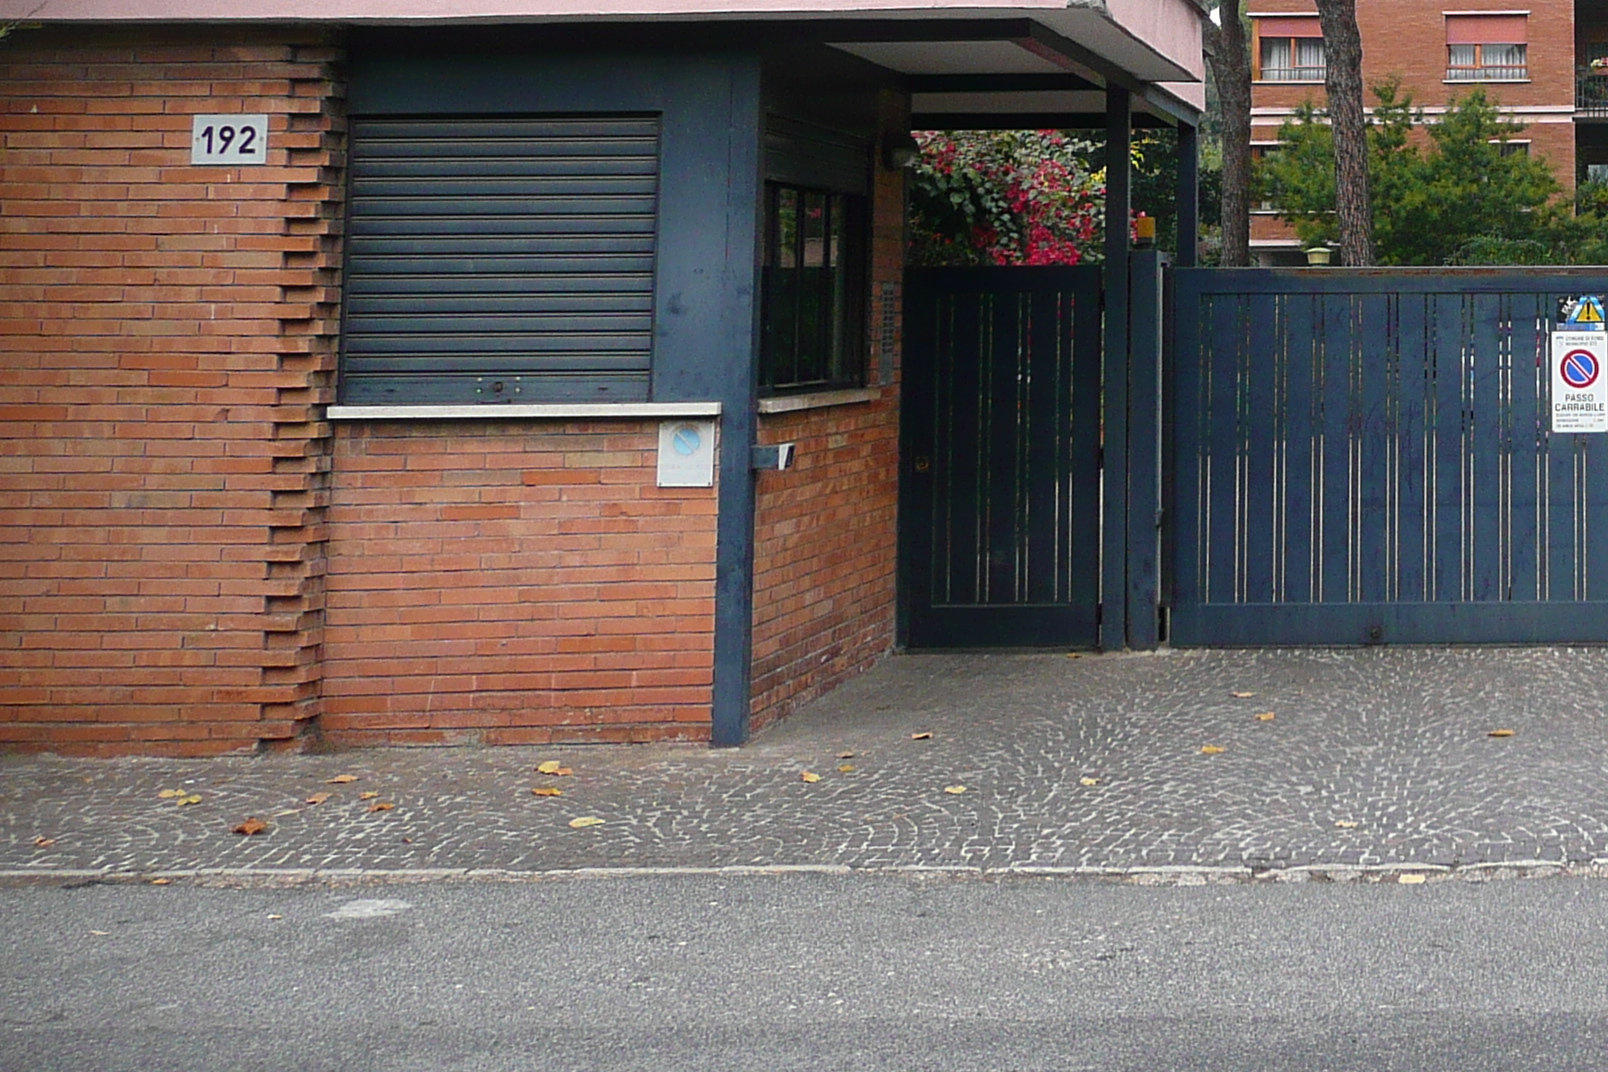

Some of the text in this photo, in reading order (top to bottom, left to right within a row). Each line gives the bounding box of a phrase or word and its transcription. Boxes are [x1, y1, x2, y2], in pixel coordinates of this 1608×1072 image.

[201, 125, 257, 155] 192
[1565, 393, 1594, 402] PASSO
[1555, 403, 1605, 412] CARRABILE
